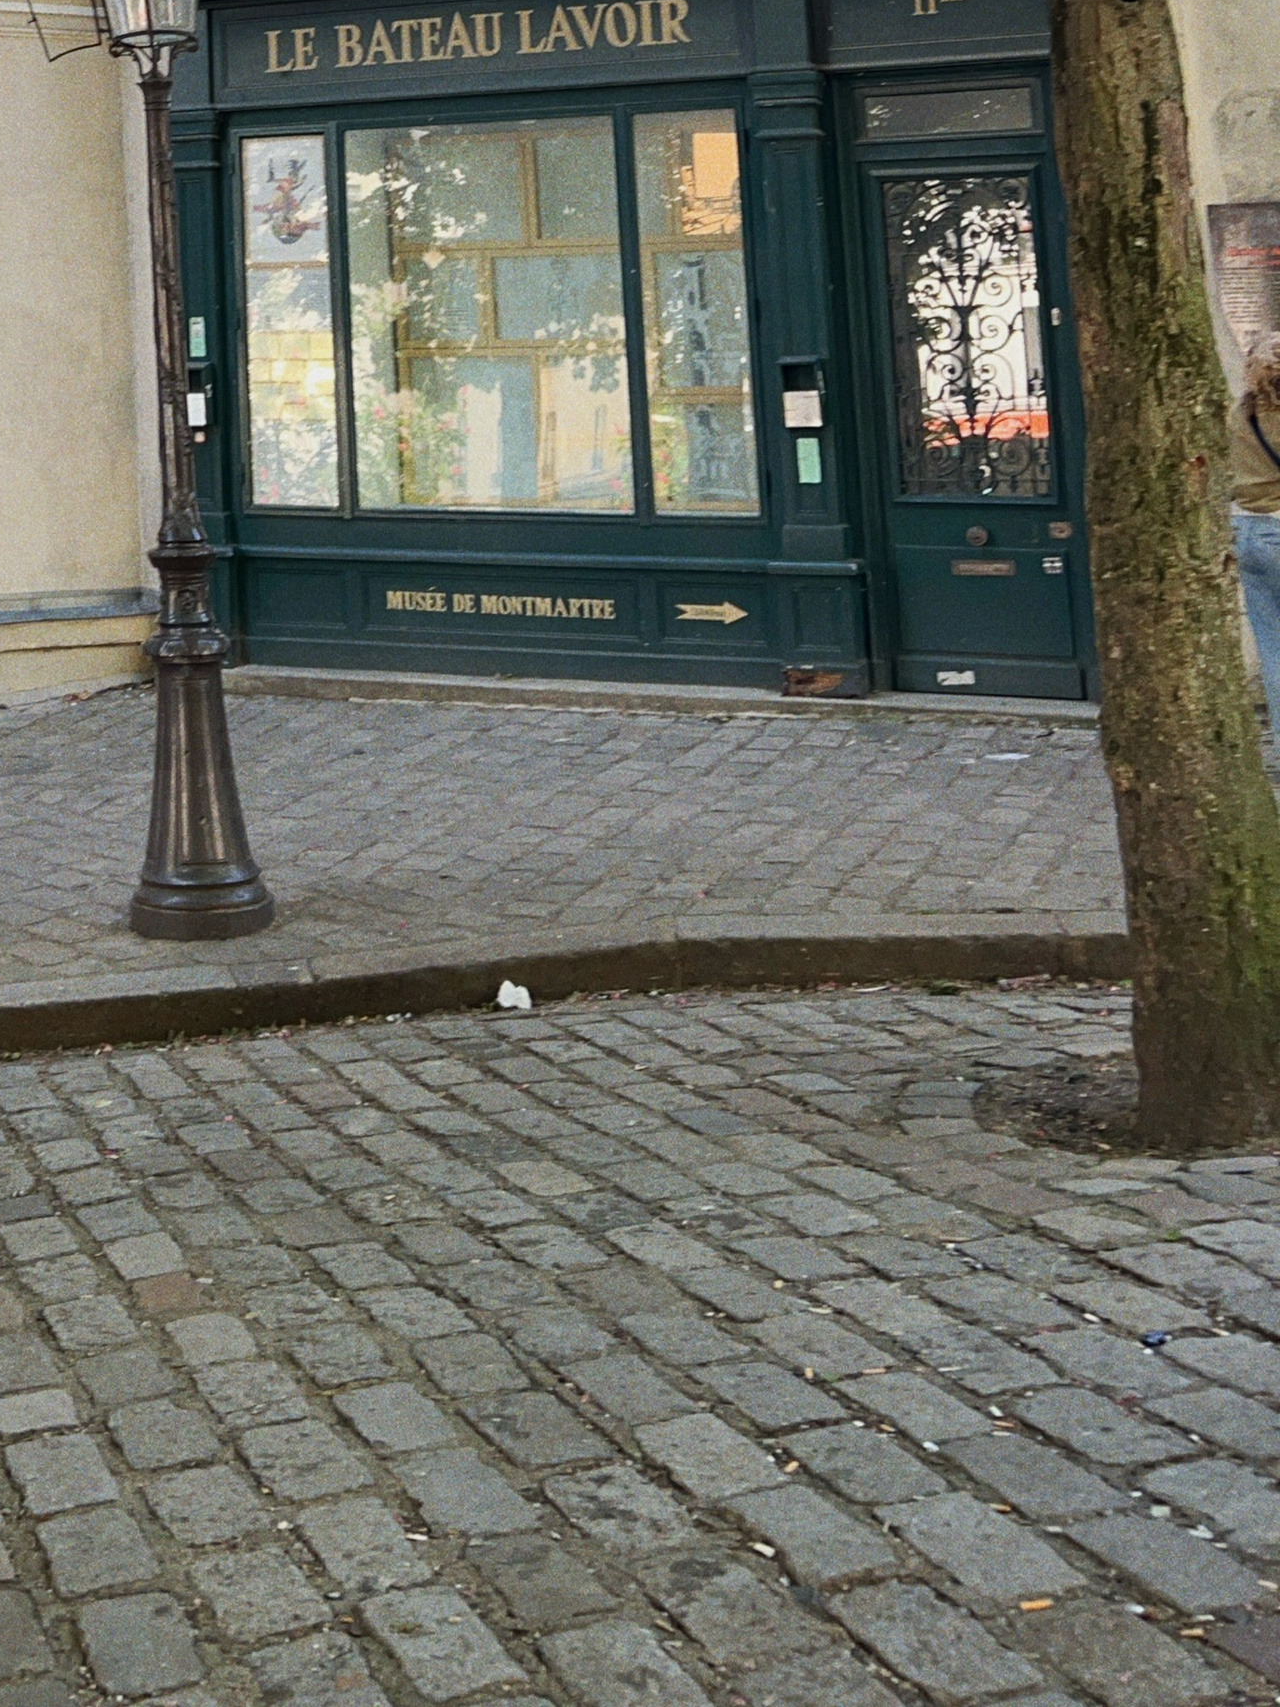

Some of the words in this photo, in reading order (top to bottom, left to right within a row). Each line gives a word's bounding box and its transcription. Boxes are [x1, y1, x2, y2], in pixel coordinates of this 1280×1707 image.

[264, 28, 318, 73] LE
[334, 11, 504, 68] BATEAU
[386, 586, 447, 611] MUSÉE
[452, 593, 476, 613] DE
[480, 594, 616, 619] MONTMARTRE
